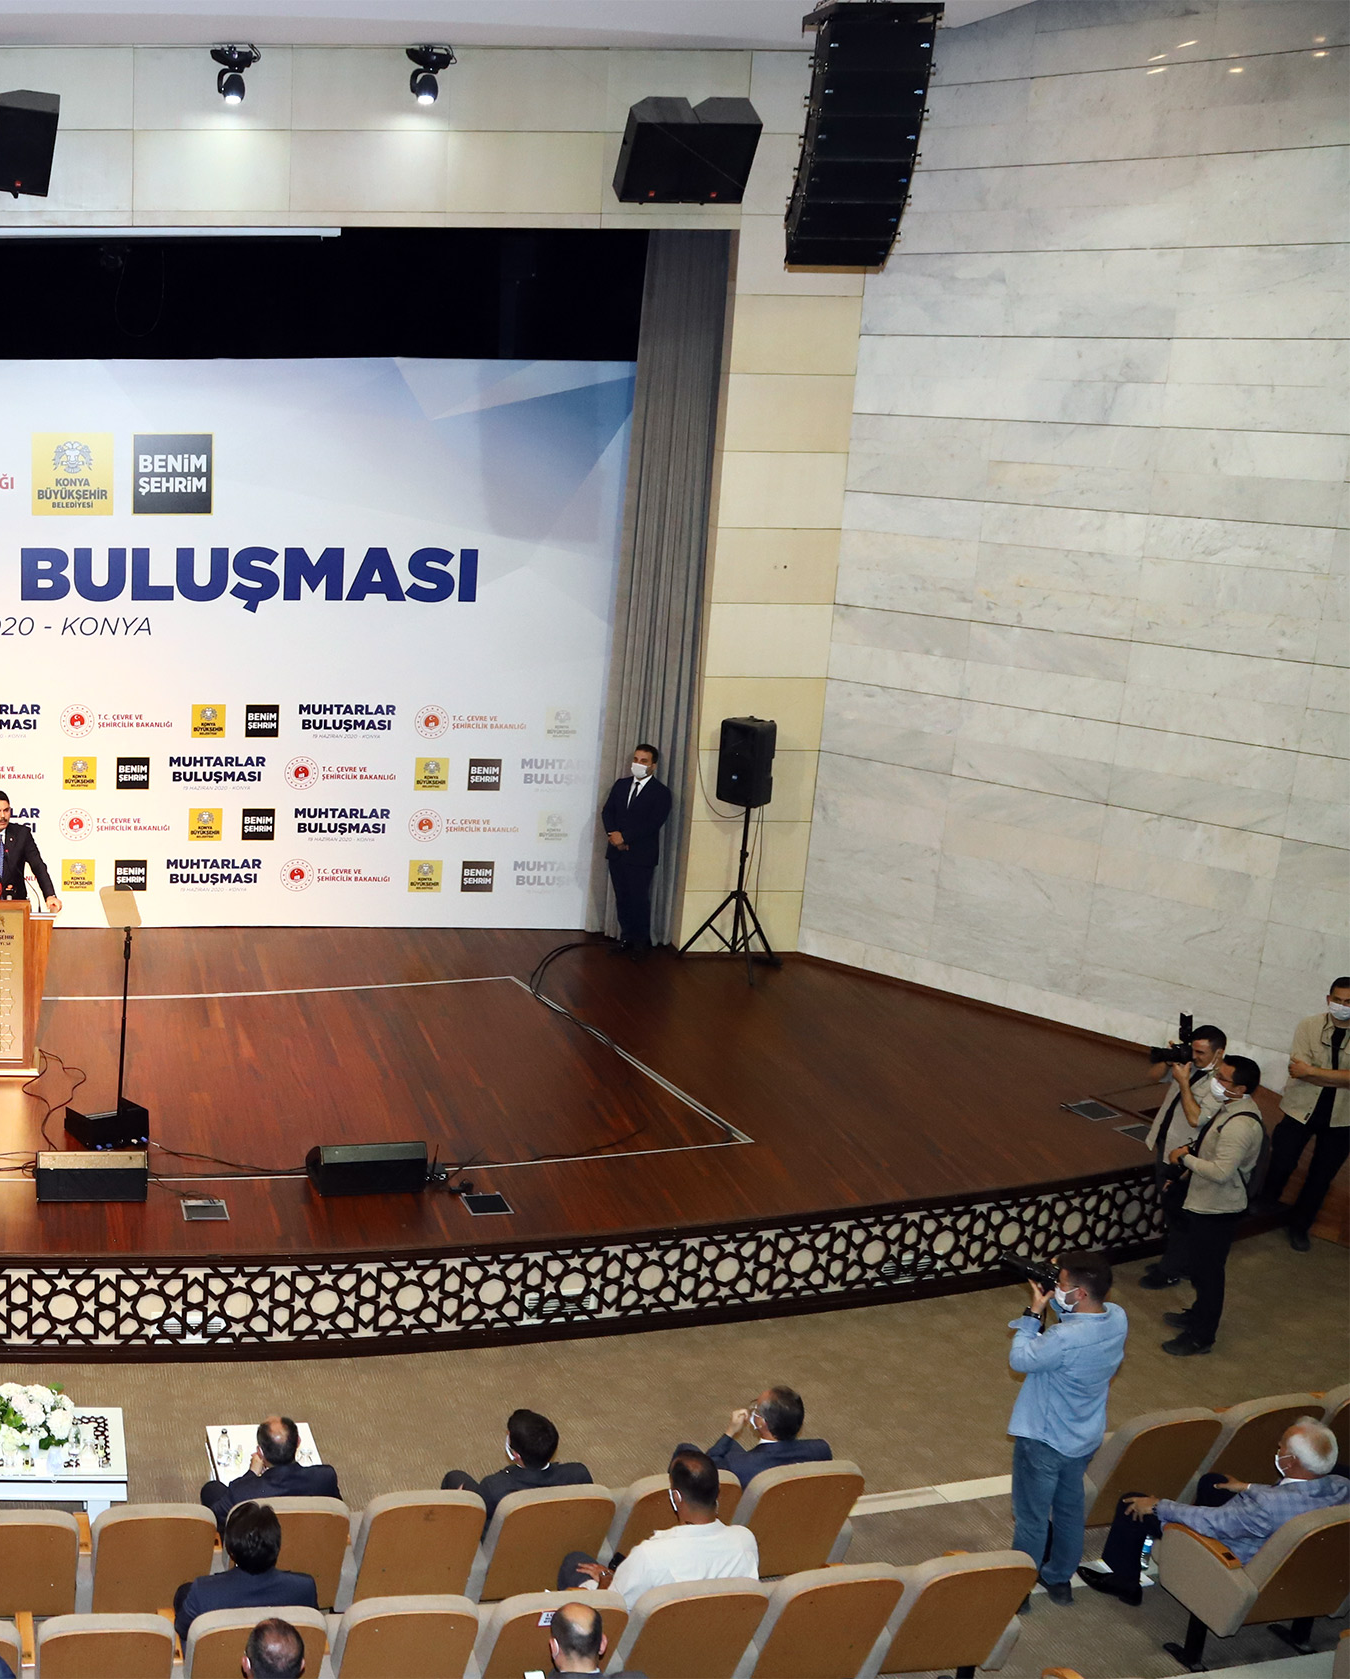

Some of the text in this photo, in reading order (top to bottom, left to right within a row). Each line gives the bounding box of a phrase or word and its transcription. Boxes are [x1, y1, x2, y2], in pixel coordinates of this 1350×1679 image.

[139, 454, 209, 474] BENİM
[55, 478, 90, 487] KONYA
[138, 476, 206, 496] ŞEHRİM
[37, 487, 108, 501] BÜYÜKŞEHİR
[52, 501, 93, 509] BELEDİYESİ
[21, 546, 479, 613] BULUŞMASI
[61, 617, 151, 636] KONYA
[299, 704, 396, 715] MUHTARLAR
[98, 721, 134, 729] ŞEHİRCİLİK
[302, 719, 391, 731] BULUŞMASI
[169, 756, 266, 767] MUHTARLAR
[172, 771, 261, 783] BULUŞMASI
[294, 808, 390, 819] MUHTARLAR
[297, 823, 386, 834] BULUŞMASI
[166, 859, 262, 869] MUHTARLAR
[170, 873, 257, 885] BULUŞMASI
[317, 875, 352, 883] ŞEHİRCİLİK
